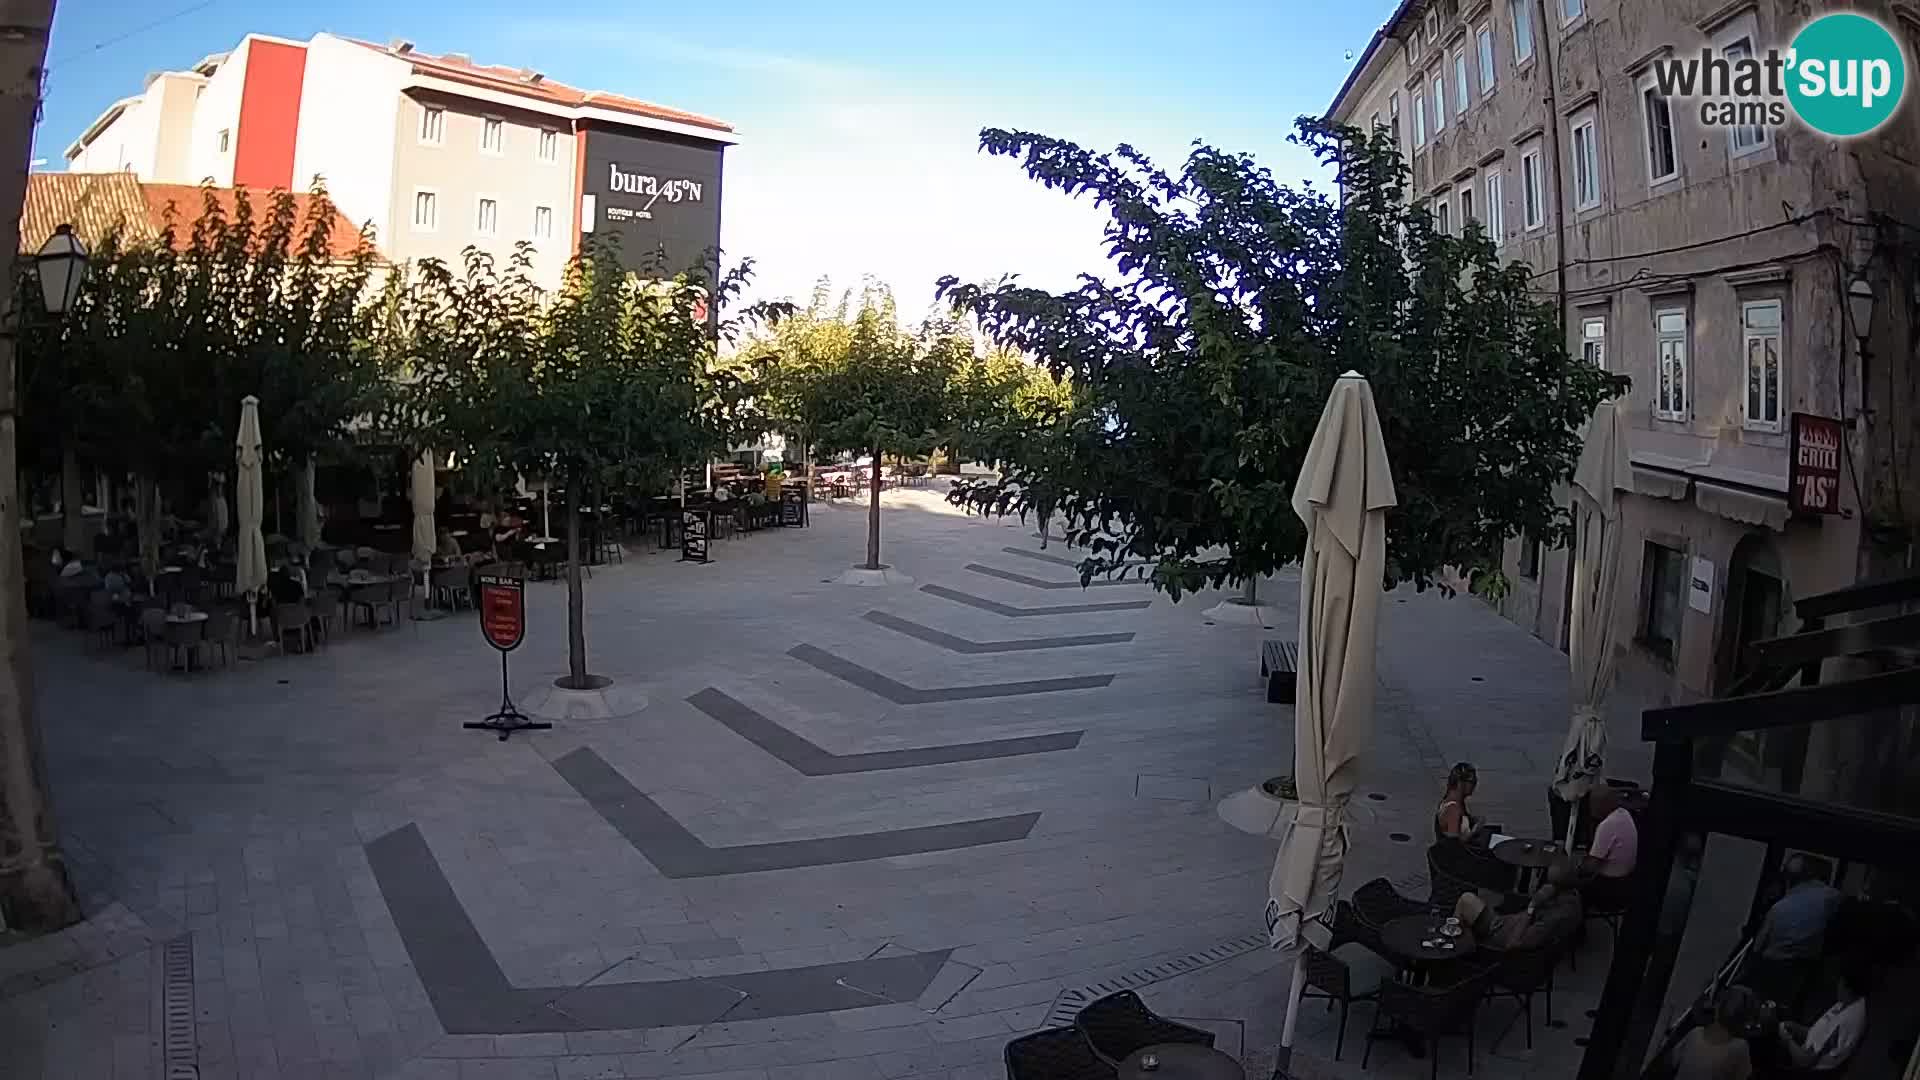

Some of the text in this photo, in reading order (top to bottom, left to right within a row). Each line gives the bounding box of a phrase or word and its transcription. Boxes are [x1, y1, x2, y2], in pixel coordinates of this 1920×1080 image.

[607, 207, 652, 219] BOUTIQUE HOTEL
[1798, 446, 1838, 470] GRILL
